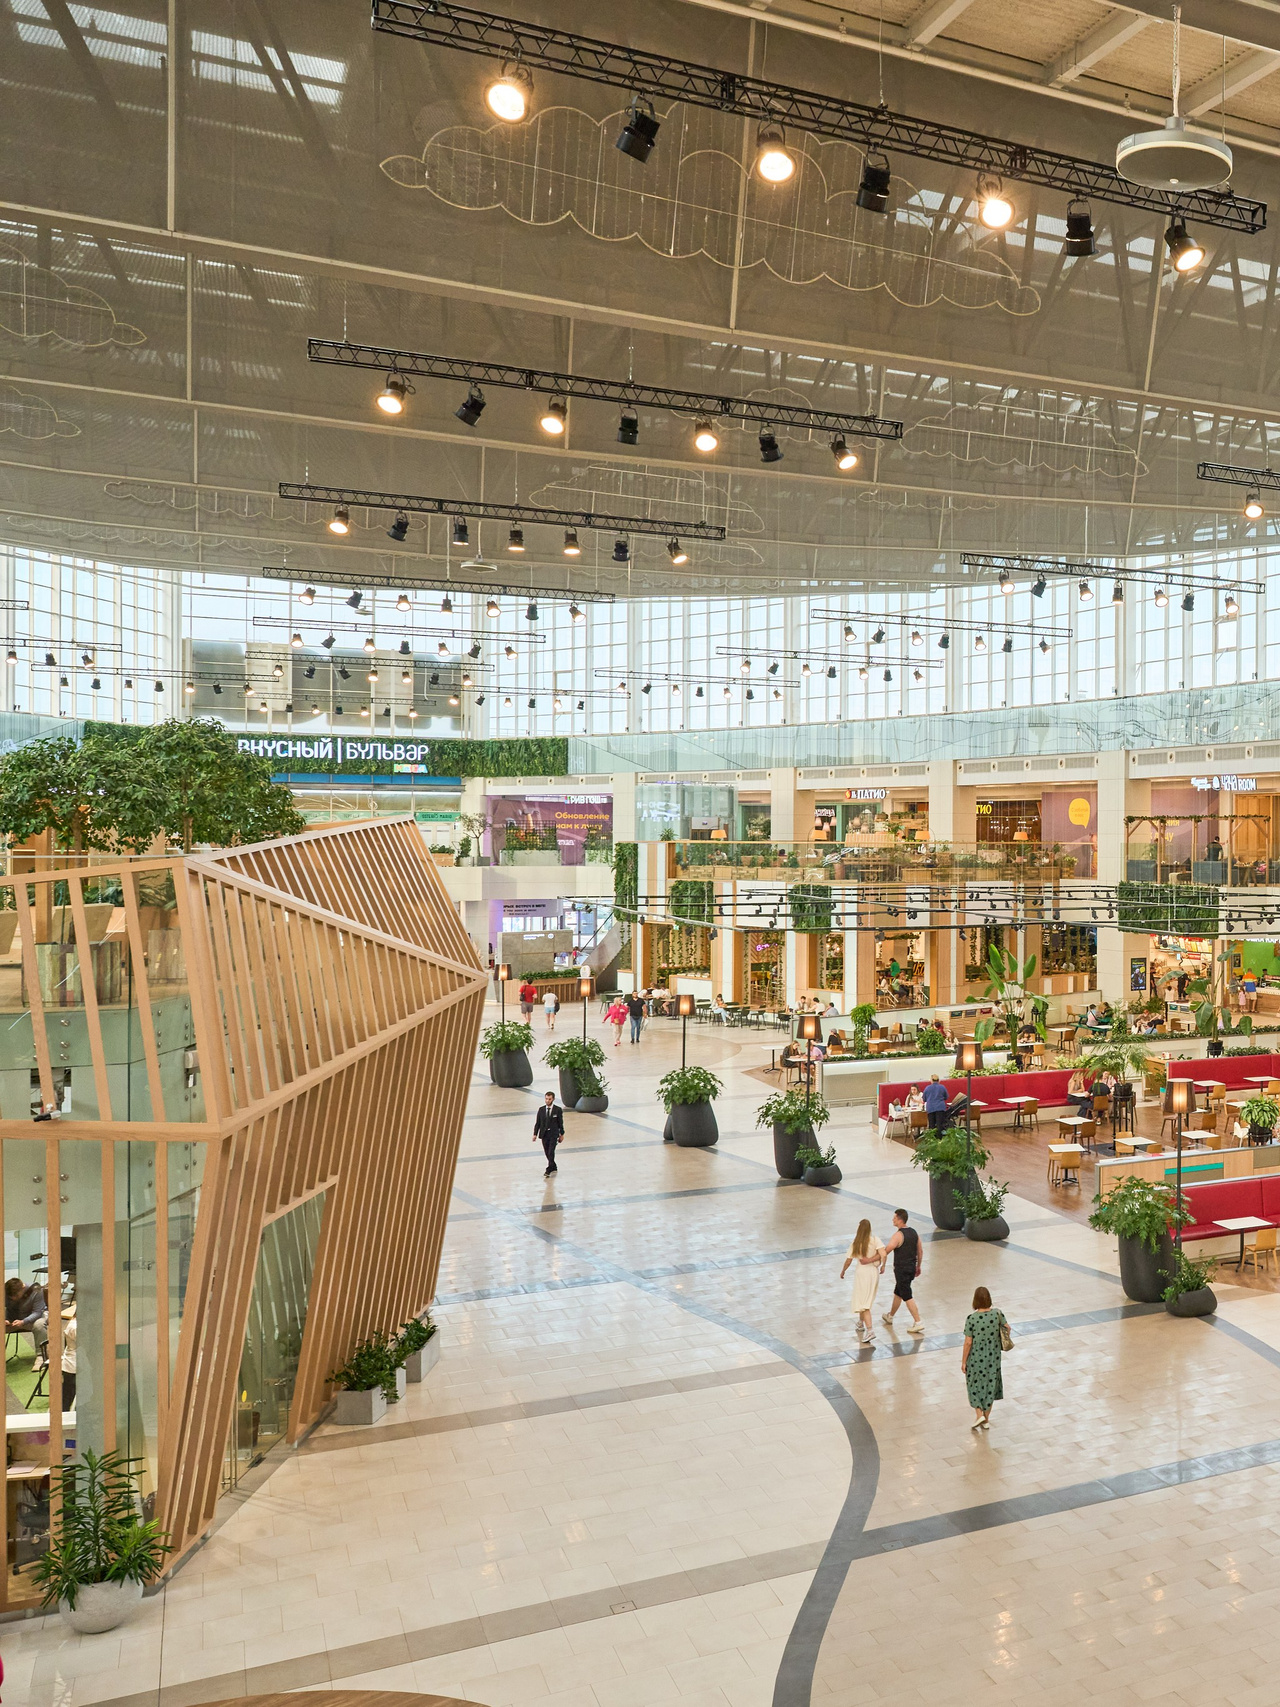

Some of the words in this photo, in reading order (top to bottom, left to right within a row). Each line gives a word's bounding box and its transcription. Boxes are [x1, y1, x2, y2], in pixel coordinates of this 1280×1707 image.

[237, 738, 333, 759] ВКУСНЫЙ
[857, 789, 886, 799] ПАТИО
[555, 811, 610, 820] Обновление
